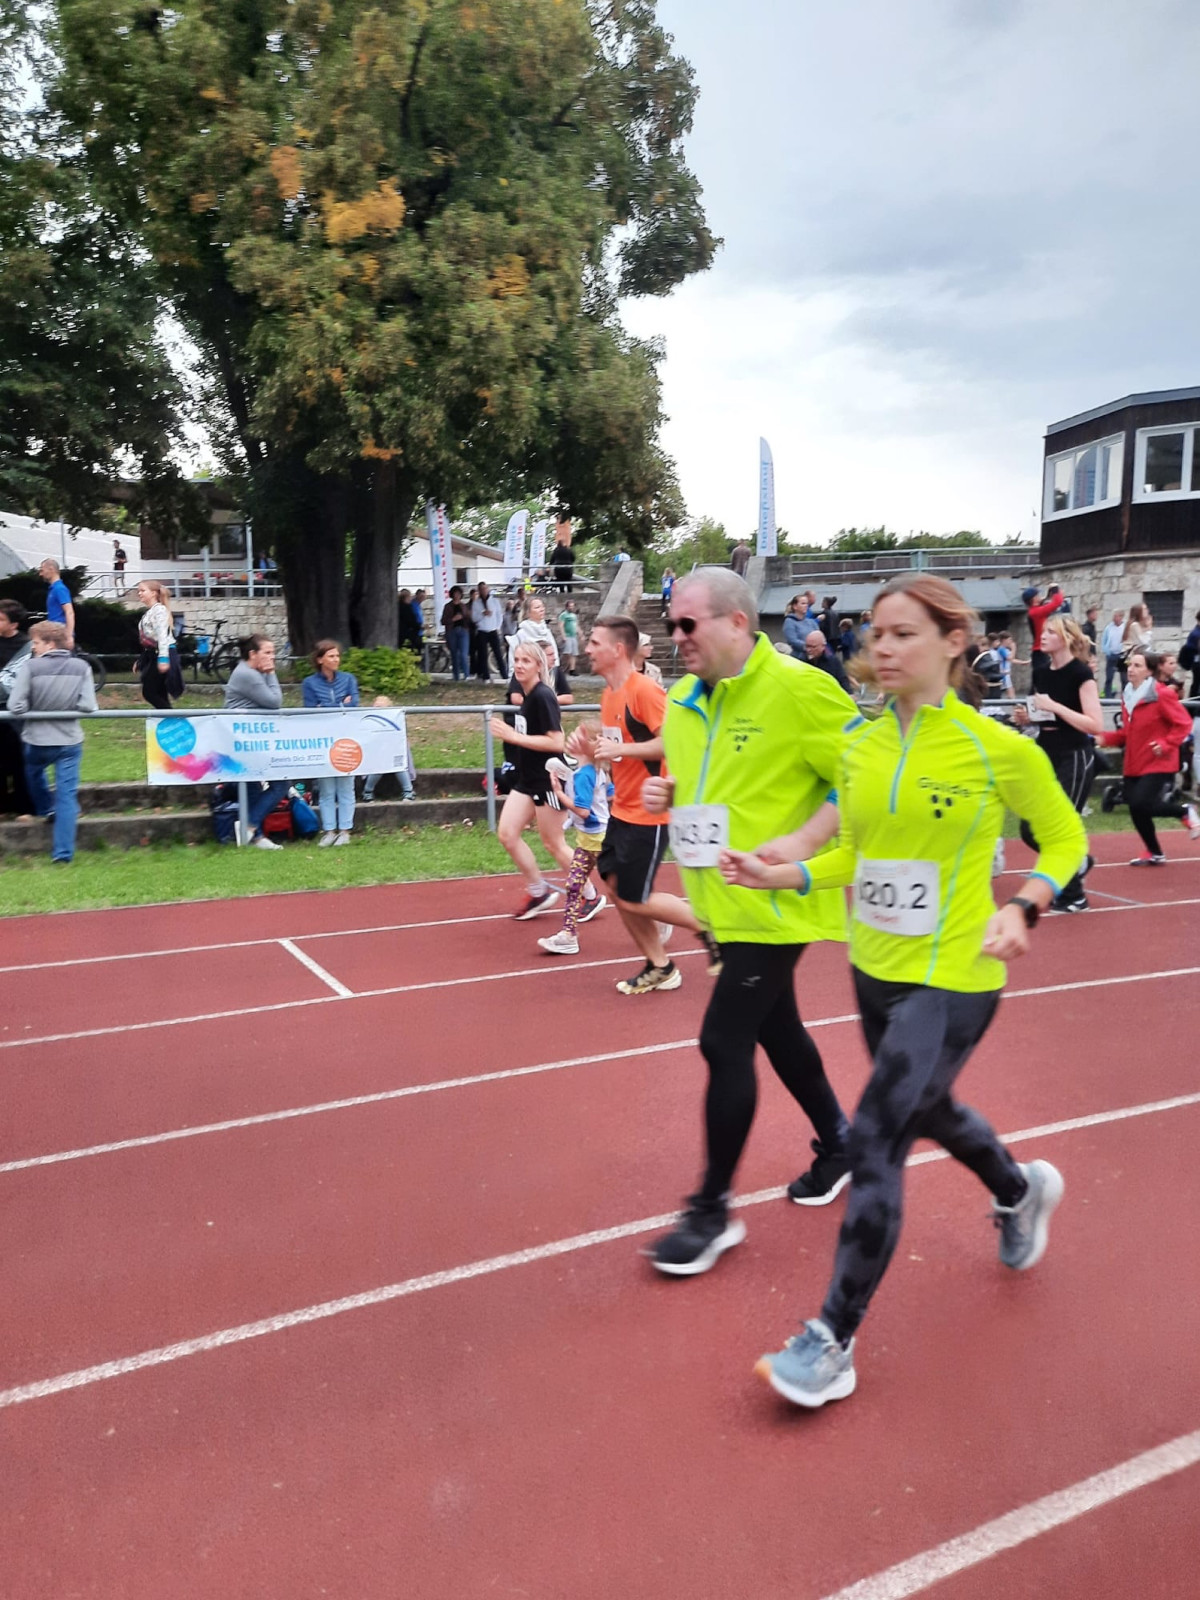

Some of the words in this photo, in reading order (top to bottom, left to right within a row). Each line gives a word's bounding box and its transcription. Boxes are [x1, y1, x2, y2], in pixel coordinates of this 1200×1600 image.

[233, 722, 280, 734] PFLEGE.
[234, 740, 270, 752] DEINE
[275, 737, 334, 750] ZUKUNFT!
